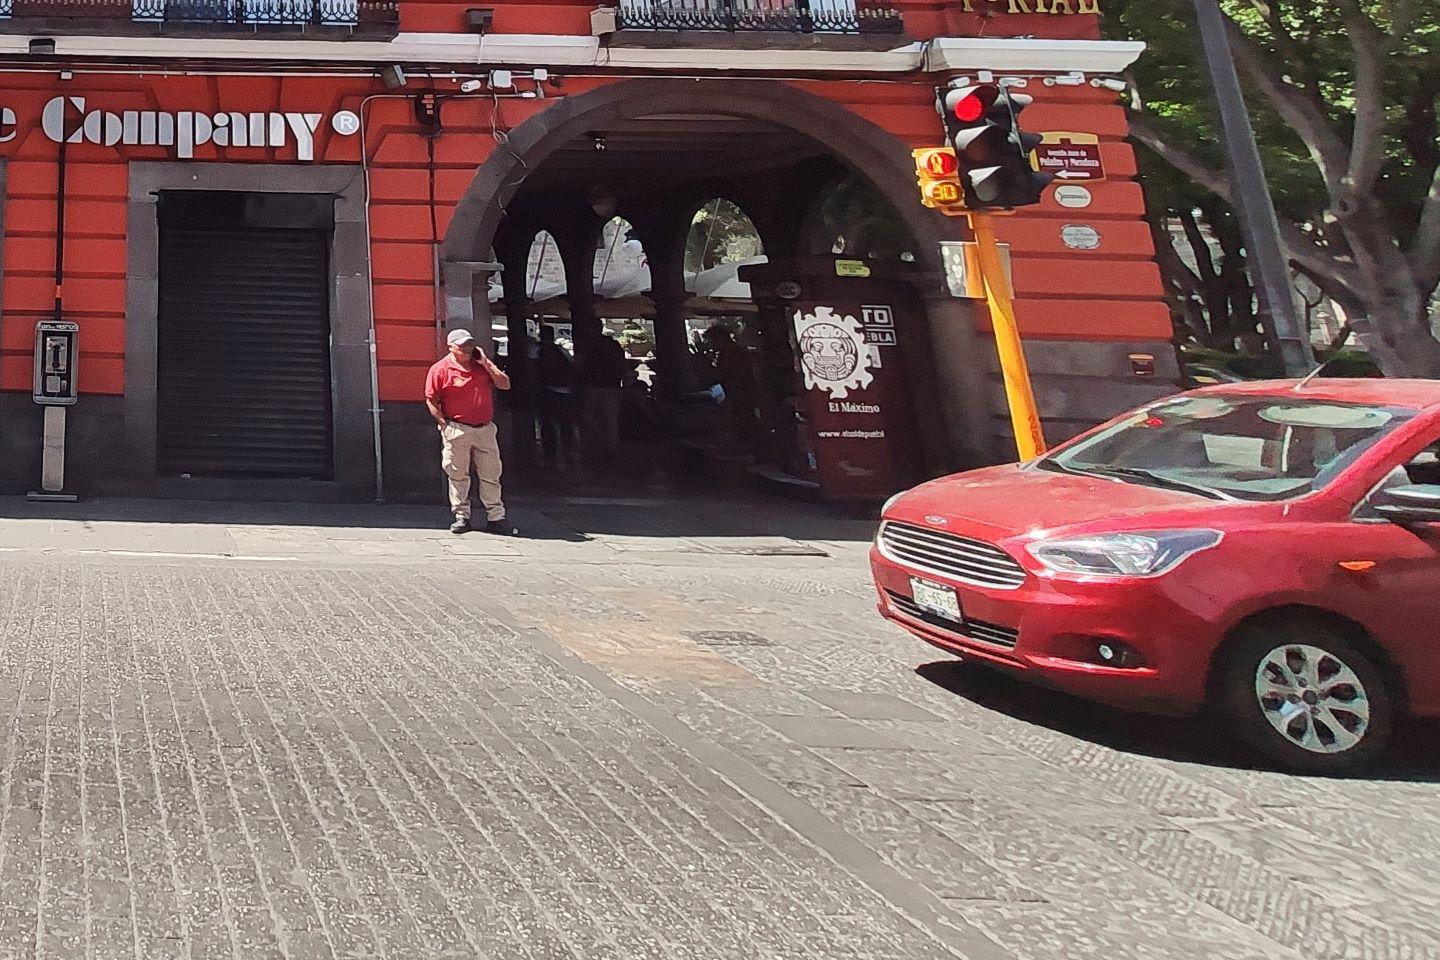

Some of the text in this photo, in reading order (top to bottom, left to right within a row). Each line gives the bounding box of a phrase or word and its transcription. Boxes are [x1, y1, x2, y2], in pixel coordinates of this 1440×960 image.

[42, 96, 323, 161] Company
[932, 184, 958, 200] 30
[828, 402, 881, 414] El Máximo
